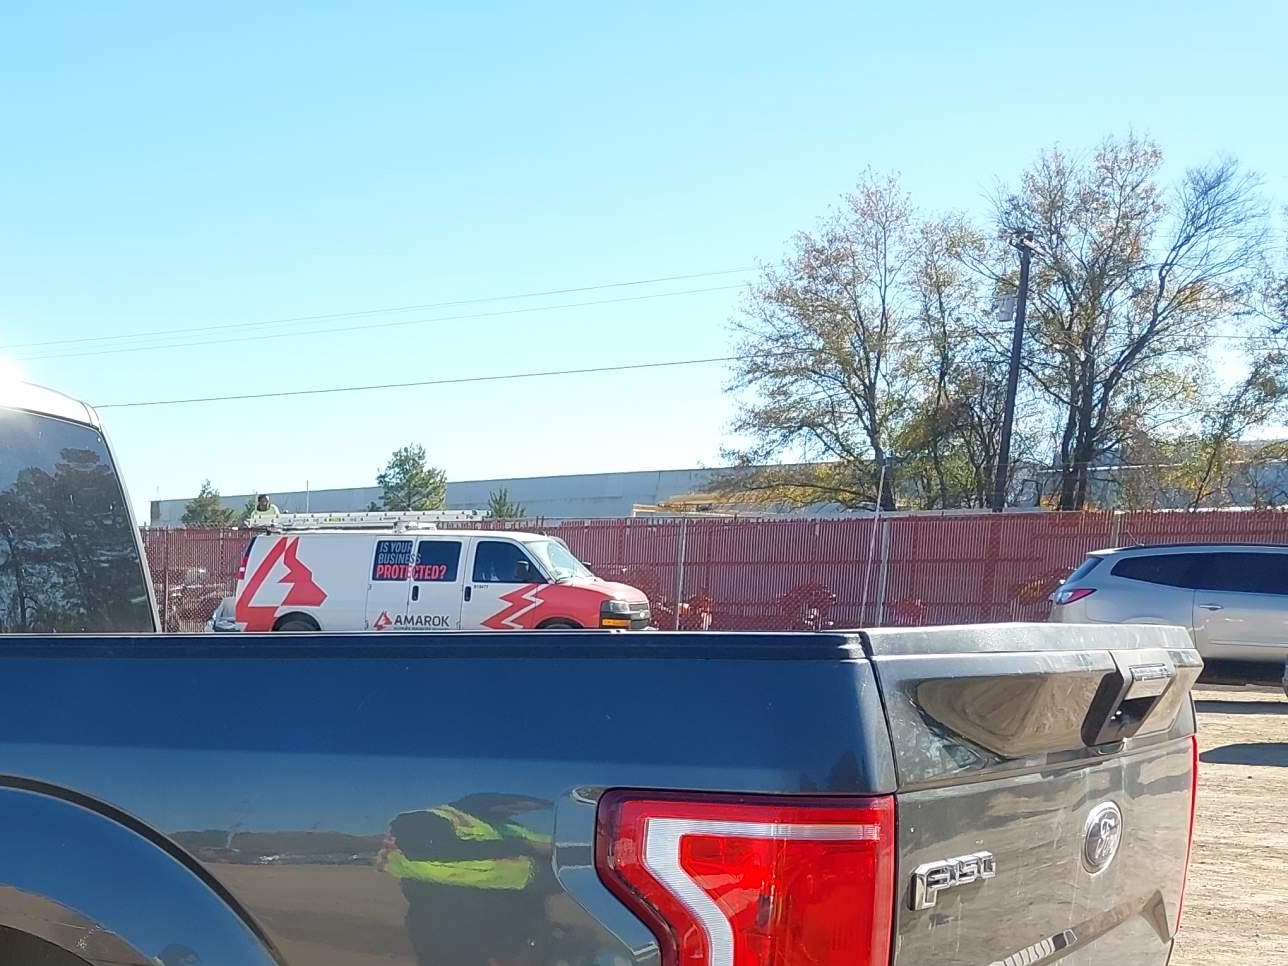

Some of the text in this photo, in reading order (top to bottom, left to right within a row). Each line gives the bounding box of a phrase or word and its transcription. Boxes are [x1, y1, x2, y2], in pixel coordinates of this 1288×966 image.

[380, 541, 413, 553] IS YOUR
[378, 553, 422, 564] BUSINESS
[376, 565, 447, 580] PROTECTED?
[394, 614, 450, 627] AMAROK
